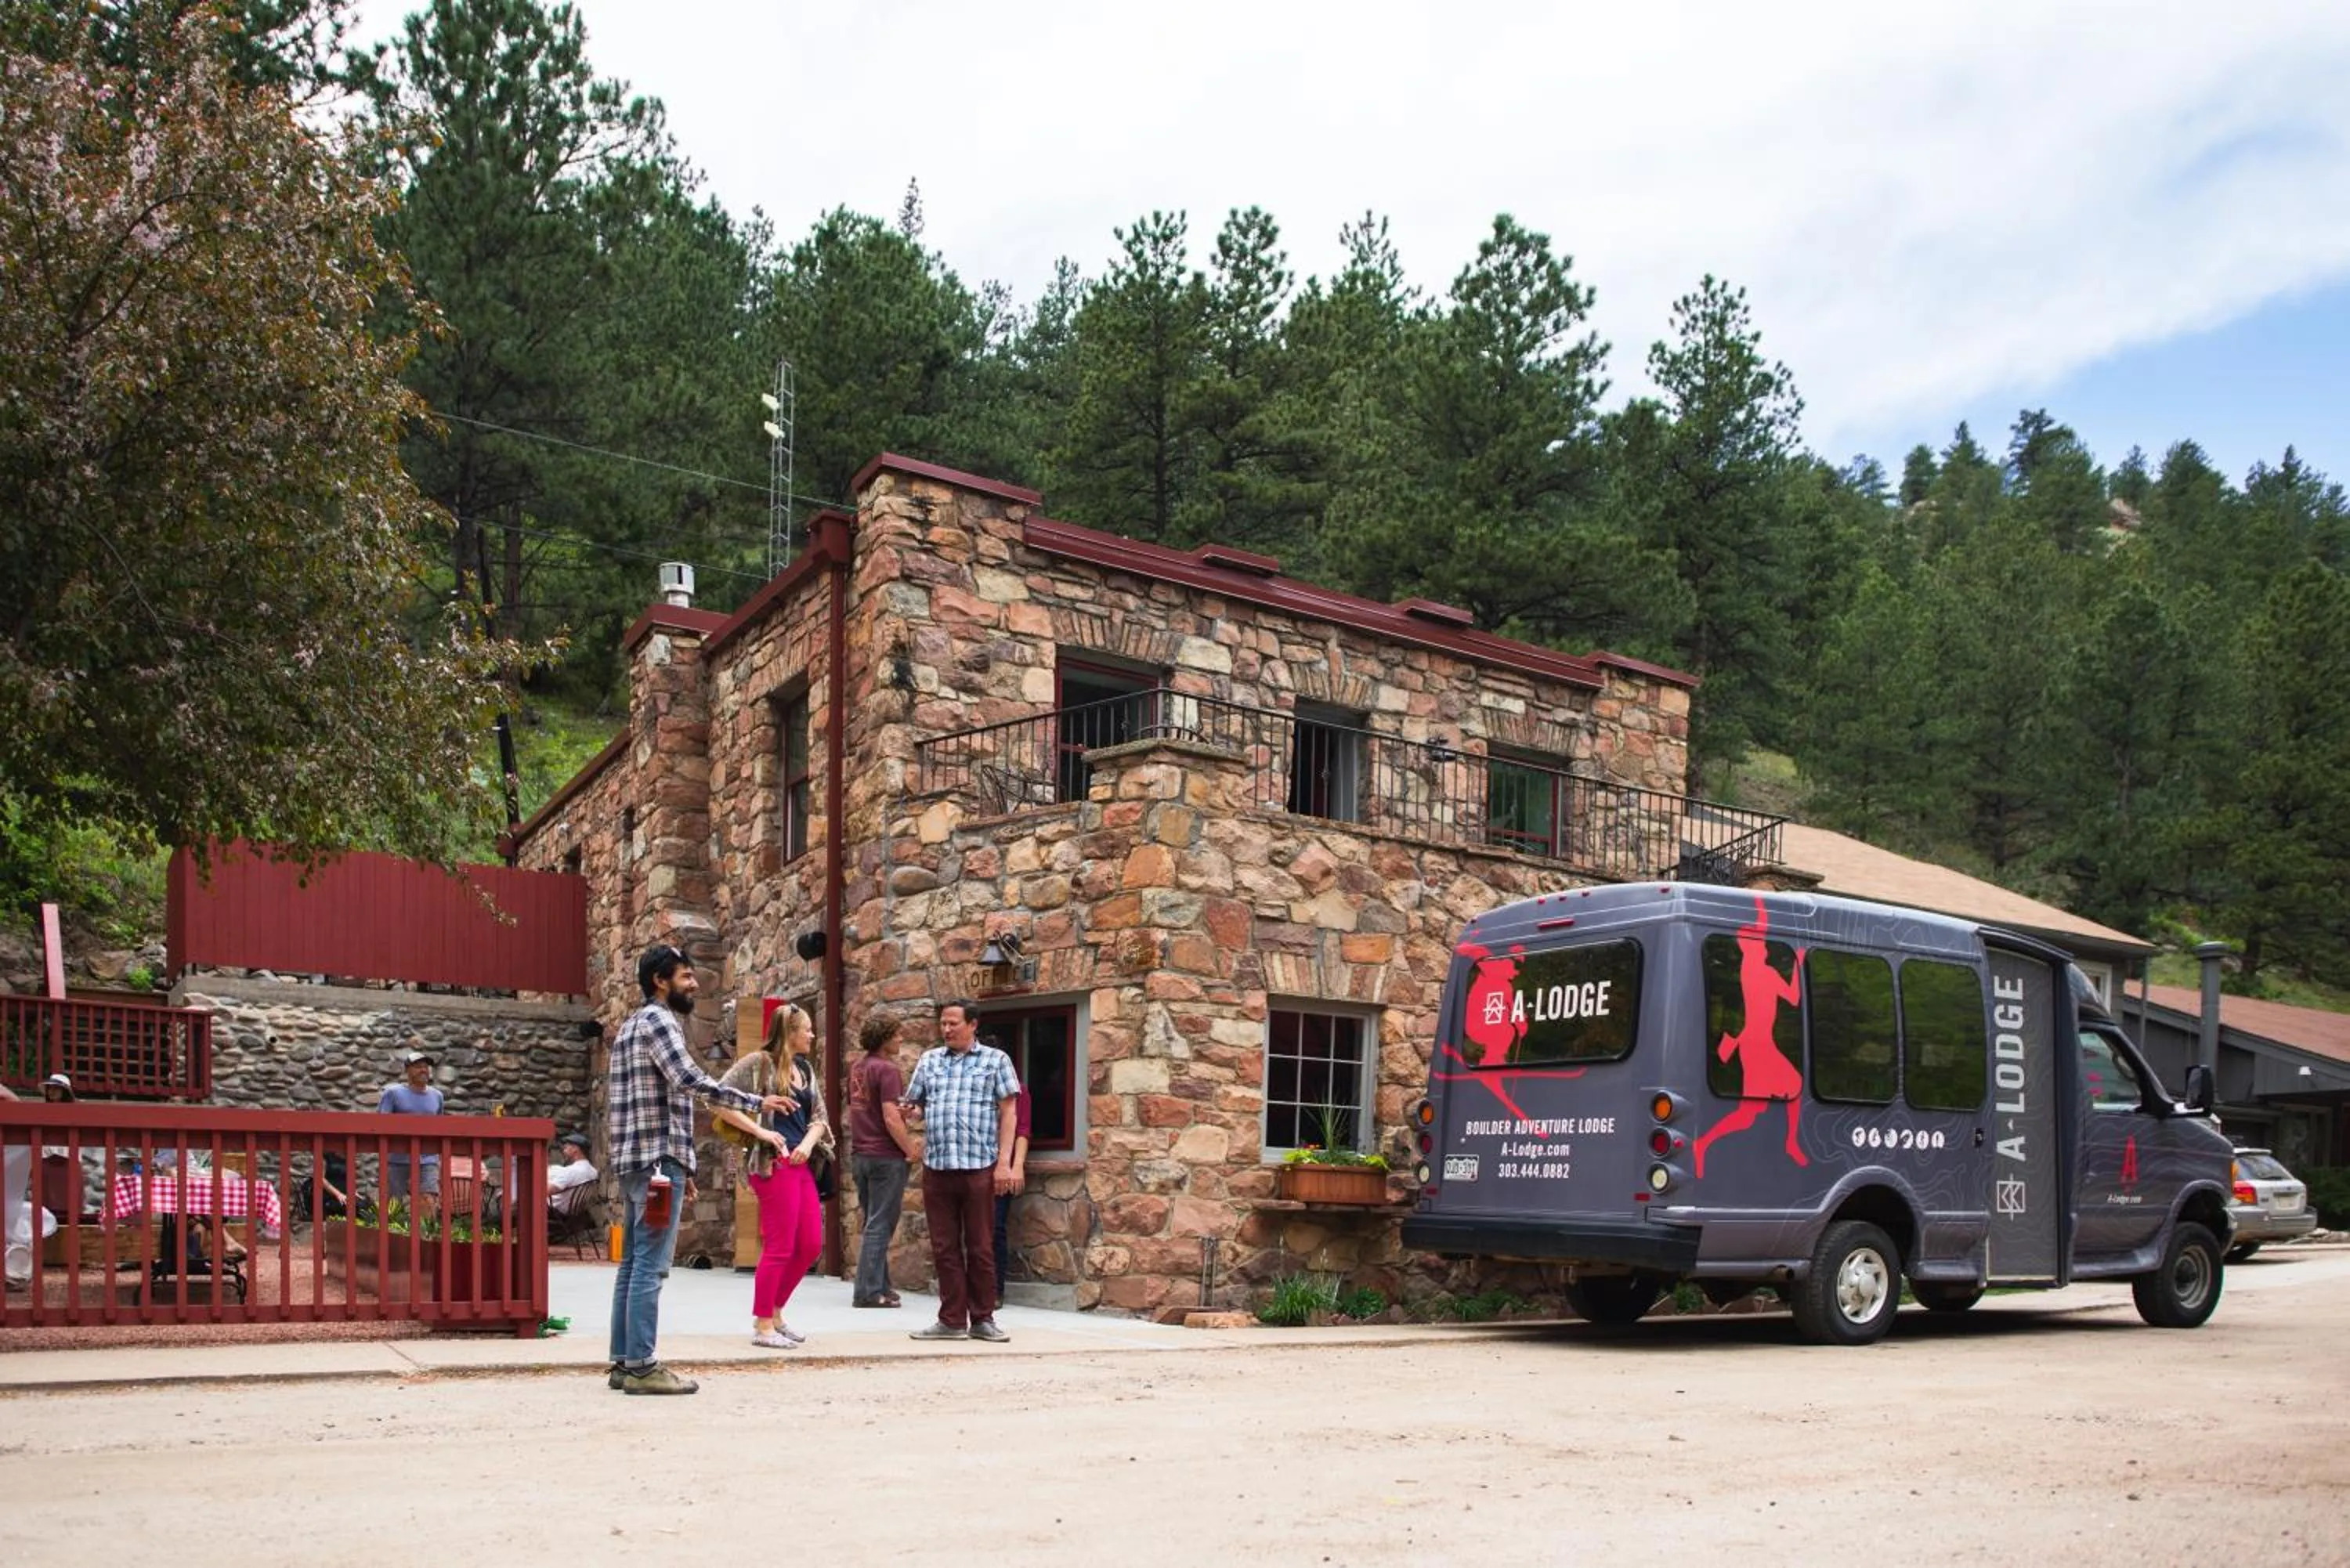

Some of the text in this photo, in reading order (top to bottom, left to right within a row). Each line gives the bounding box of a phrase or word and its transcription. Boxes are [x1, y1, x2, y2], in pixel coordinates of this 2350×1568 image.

[1466, 1118, 1615, 1135] BOULDER ADVENTURE LODGE
[1500, 1141, 1571, 1158] A-Lodge.com
[1499, 1163, 1570, 1179] 303.444.0882
